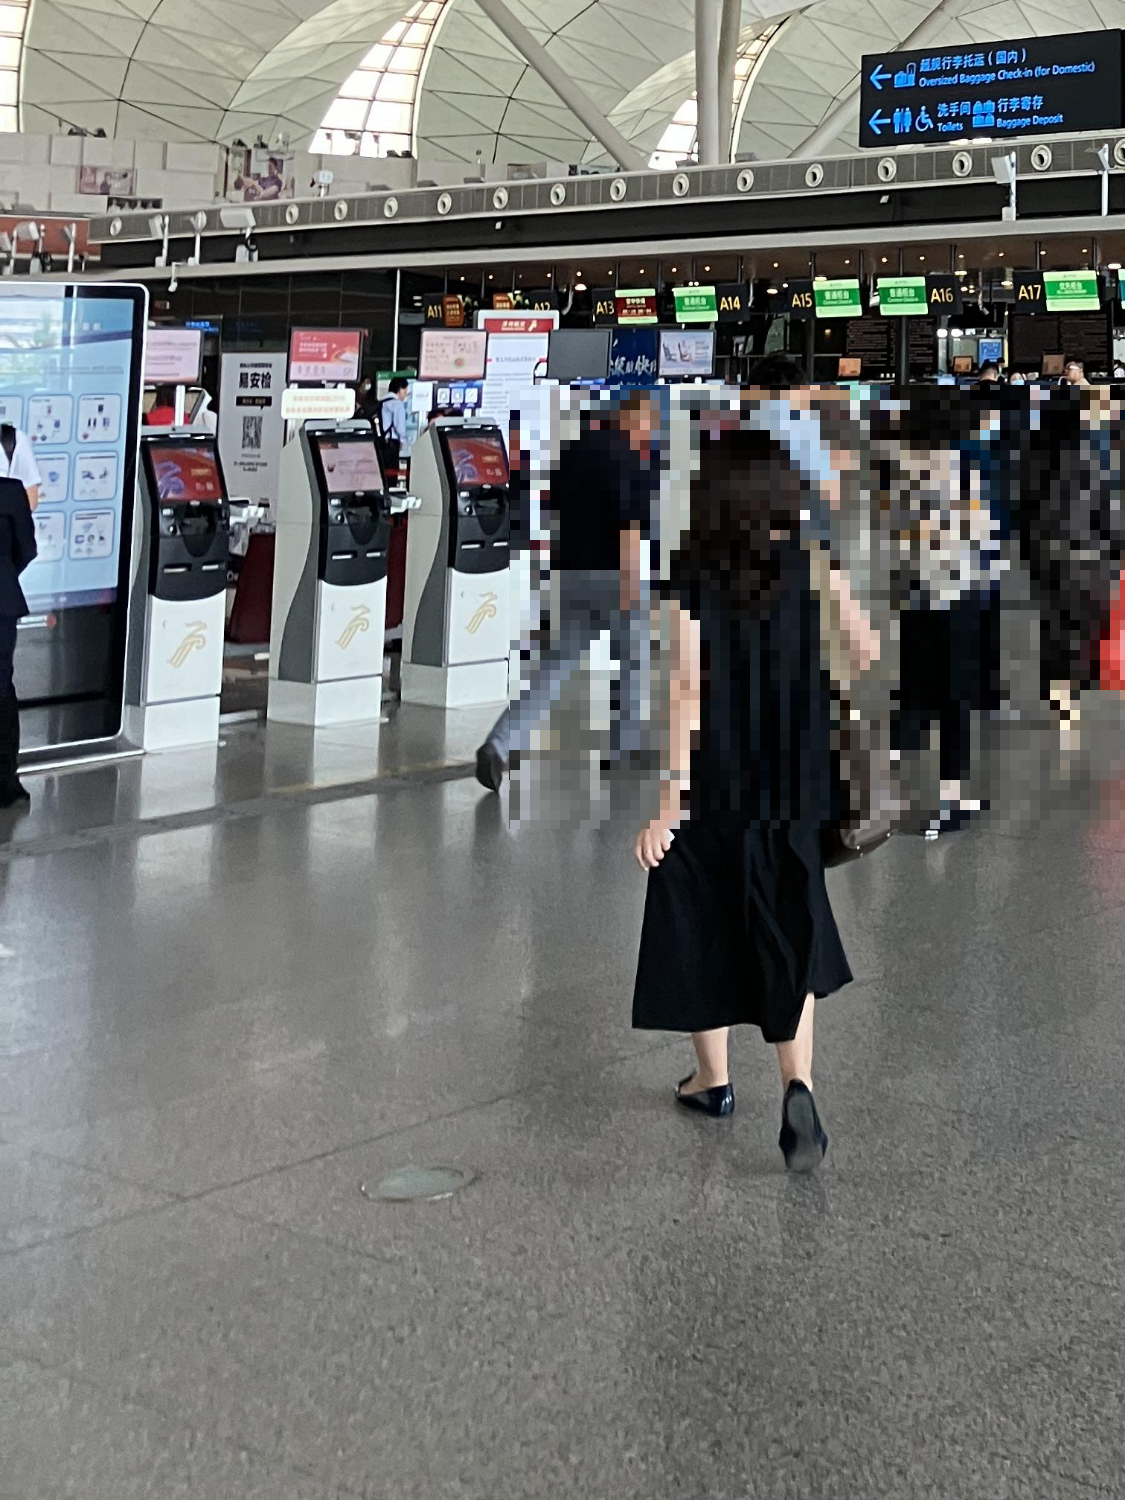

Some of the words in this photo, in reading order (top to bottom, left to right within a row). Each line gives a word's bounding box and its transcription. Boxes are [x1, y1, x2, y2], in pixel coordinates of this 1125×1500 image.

[918, 75, 958, 88] Oversized
[959, 71, 995, 85] Baggage
[997, 67, 1033, 80] Check-in
[1034, 64, 1051, 79] (for
[1052, 61, 1096, 75] Domestic)
[937, 101, 971, 118] 洗手间
[997, 95, 1044, 113] 行李寄存
[937, 121, 964, 133] Toilets
[997, 117, 1031, 130] Baggage
[1032, 113, 1064, 127] Deposit
[930, 288, 954, 303] A16
[1018, 284, 1041, 300] A17
[596, 301, 615, 316] A13
[719, 296, 741, 312] A14
[791, 293, 813, 308] A15
[427, 303, 443, 318] A11
